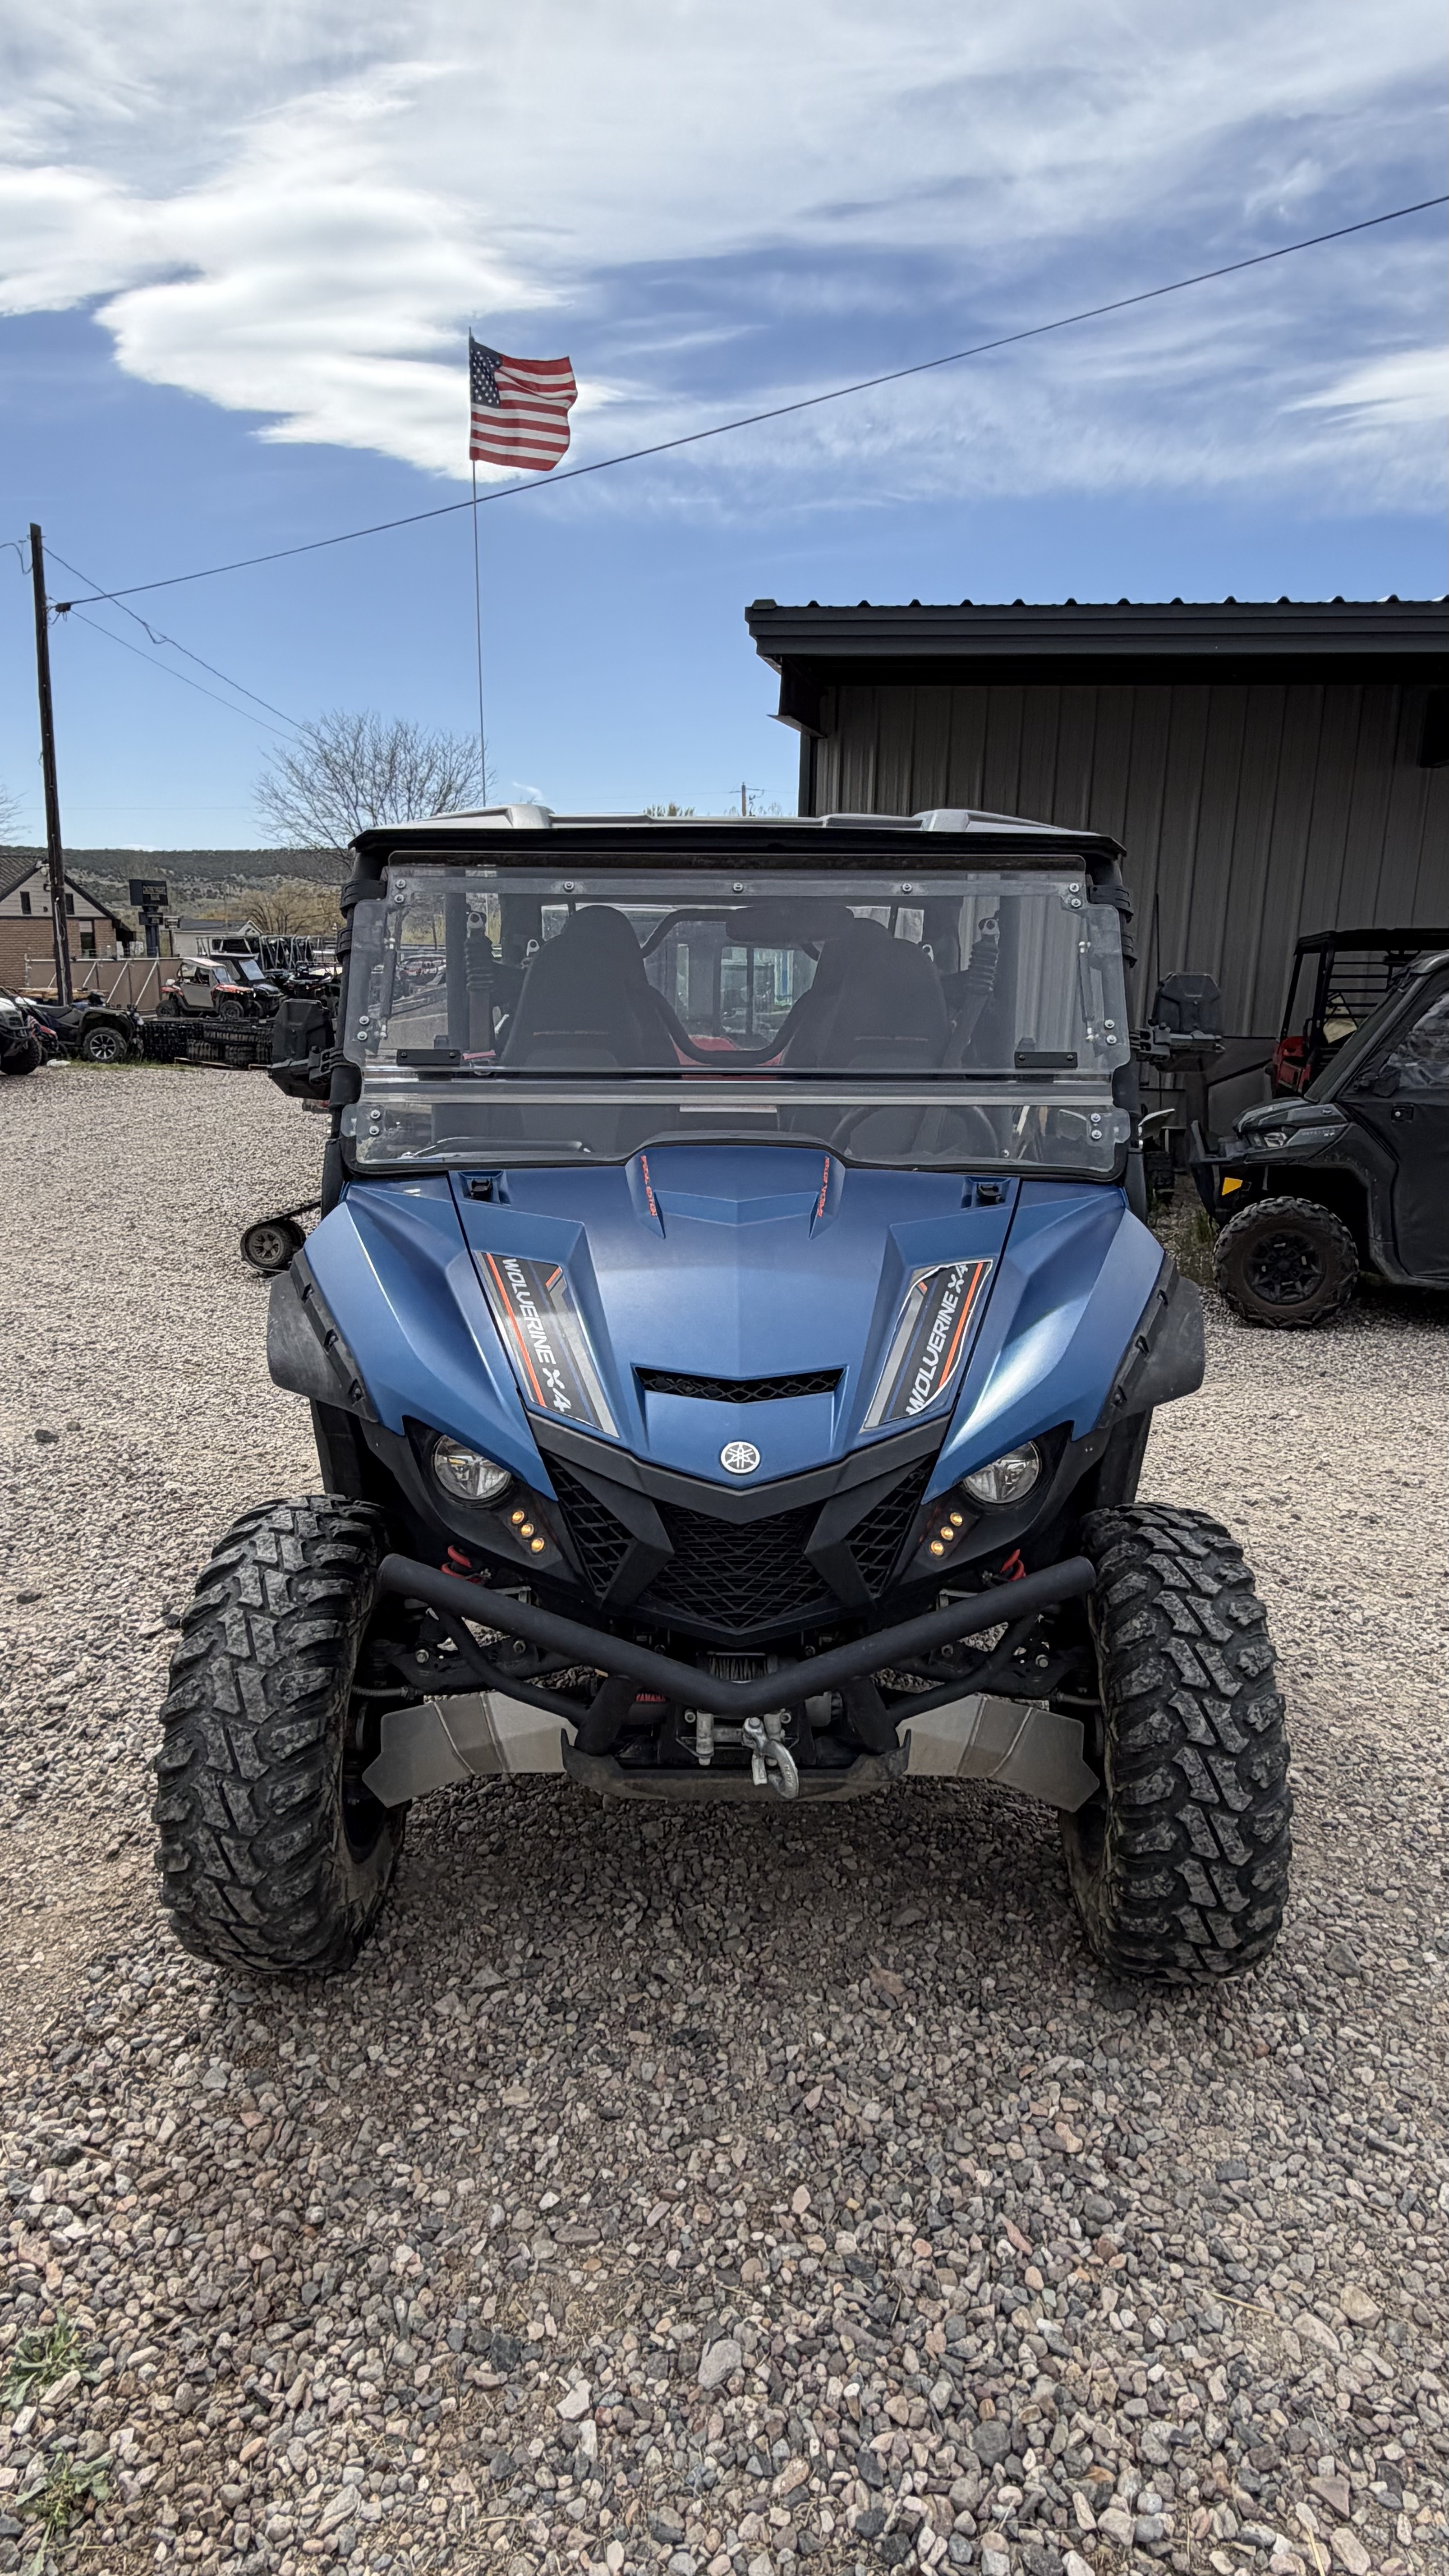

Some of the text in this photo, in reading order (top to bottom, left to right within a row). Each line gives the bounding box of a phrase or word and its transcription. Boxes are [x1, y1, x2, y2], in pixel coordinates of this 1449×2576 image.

[502, 1258, 572, 1412] WOLVERINE X4
[906, 1291, 959, 1415] WOLVERINE
